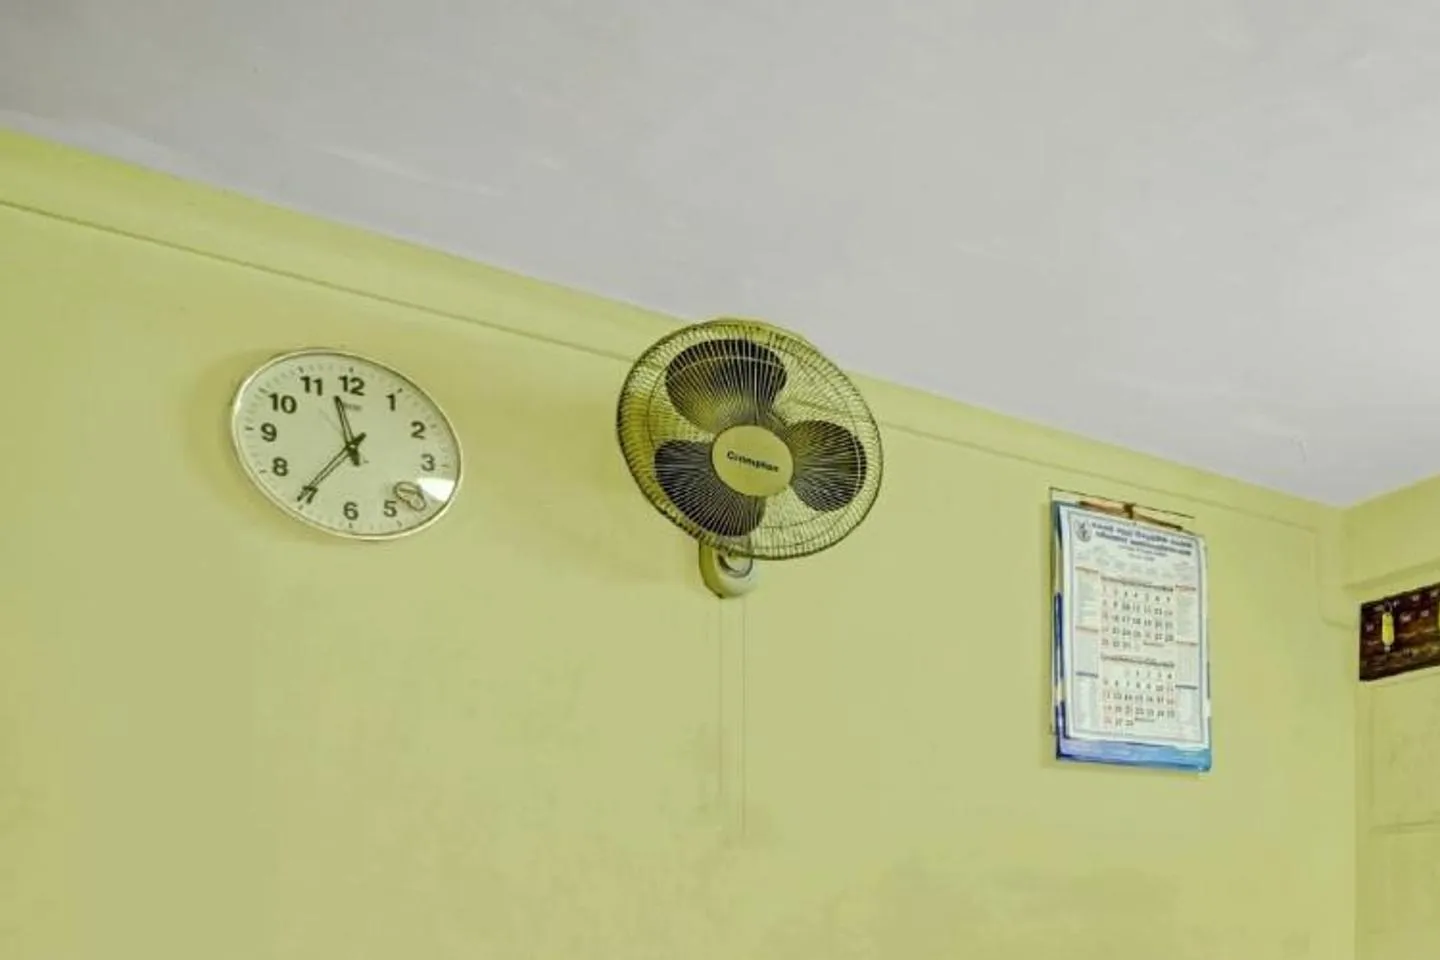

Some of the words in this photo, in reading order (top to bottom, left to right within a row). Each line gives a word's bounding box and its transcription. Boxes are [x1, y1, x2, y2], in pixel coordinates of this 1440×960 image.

[300, 376, 323, 396] 11
[338, 375, 365, 396] 12
[268, 392, 297, 414] 10
[386, 394, 396, 412] 1
[260, 422, 277, 442] 9
[411, 421, 426, 440] 2
[272, 457, 289, 477] 8
[420, 453, 436, 471] 3
[302, 485, 319, 504] 7
[343, 501, 359, 520] 6
[383, 500, 398, 518] 5
